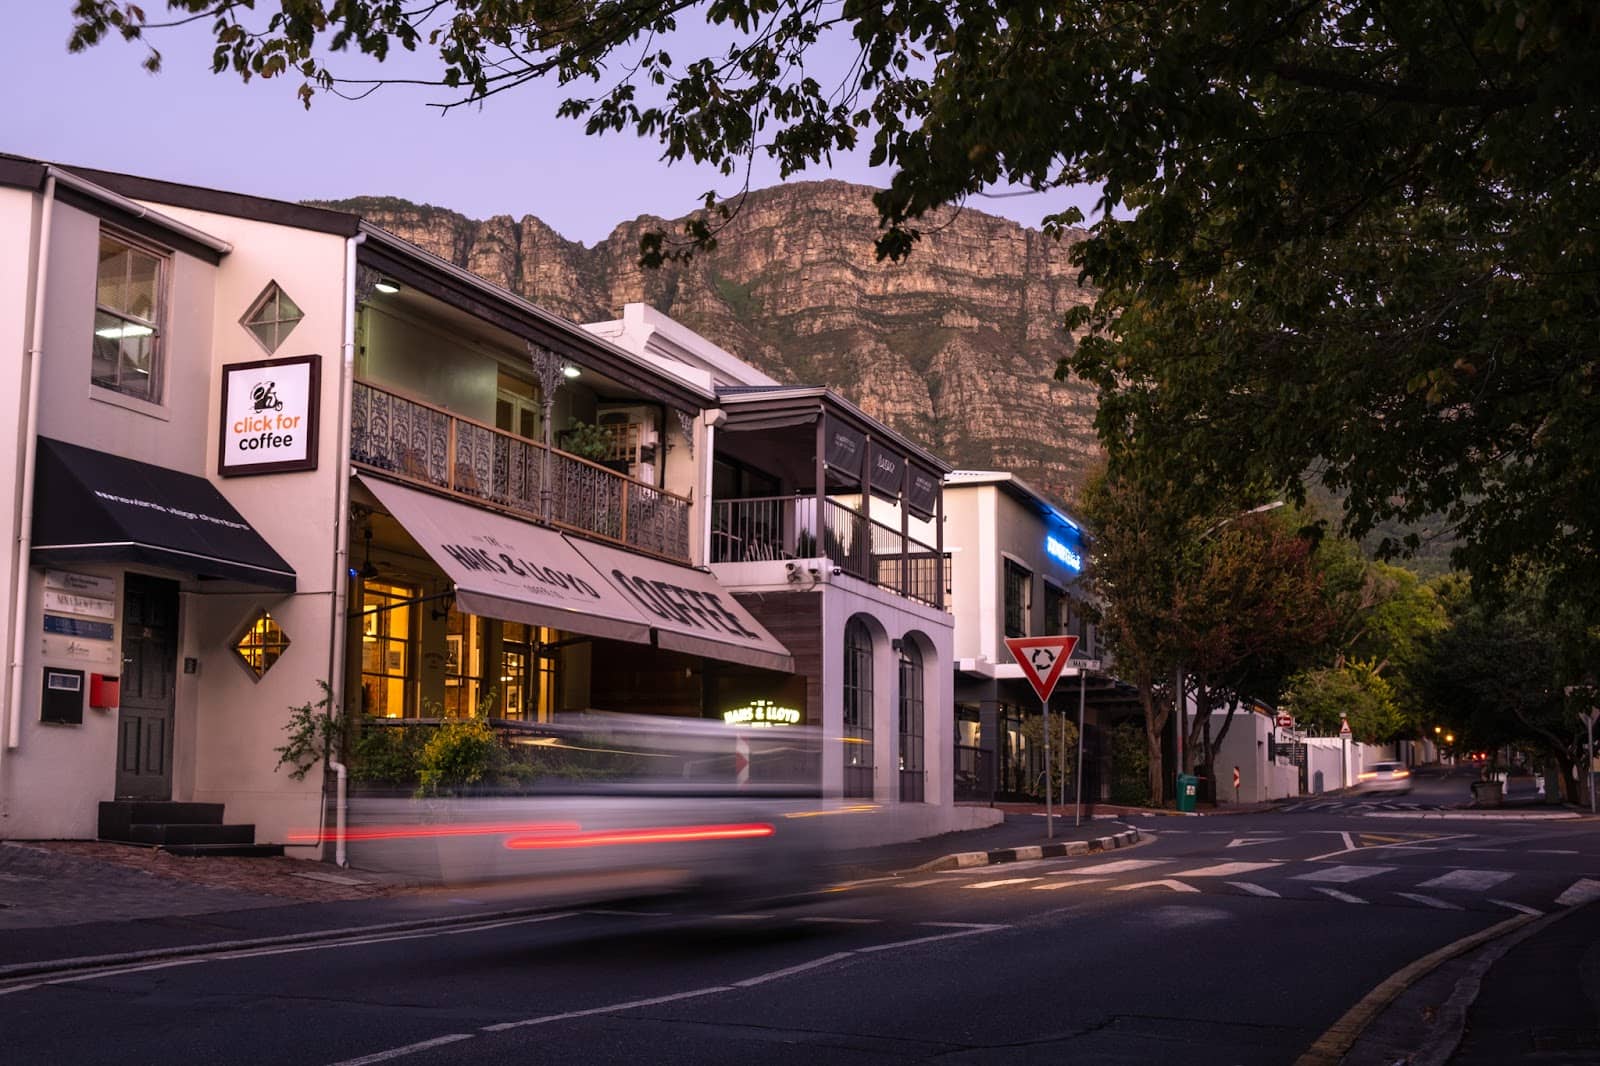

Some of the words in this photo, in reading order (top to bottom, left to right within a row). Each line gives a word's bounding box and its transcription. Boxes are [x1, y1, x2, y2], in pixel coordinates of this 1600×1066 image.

[233, 415, 272, 434] click
[276, 413, 301, 430] for
[239, 432, 293, 451] coffee
[441, 544, 507, 574] HANS
[499, 553, 528, 577] &
[518, 558, 601, 598] LLOYD
[611, 569, 763, 641] COFFEE
[724, 707, 754, 724] HANS
[755, 707, 765, 720] &
[766, 707, 800, 723] LLOYD
